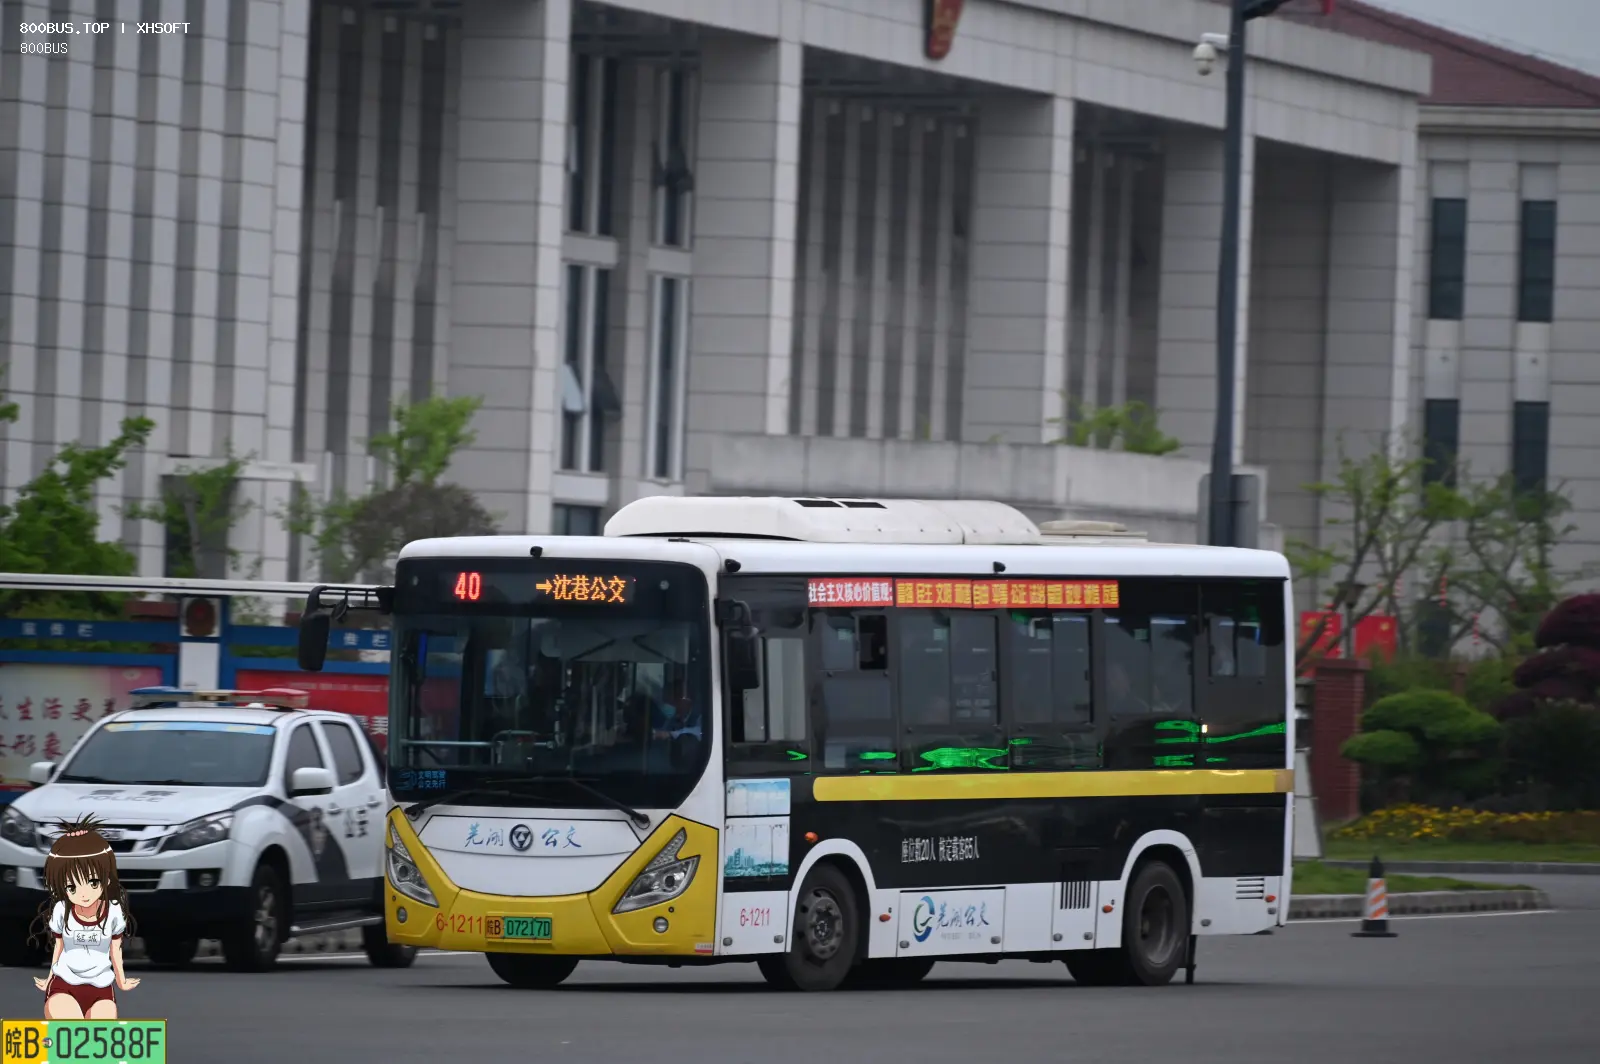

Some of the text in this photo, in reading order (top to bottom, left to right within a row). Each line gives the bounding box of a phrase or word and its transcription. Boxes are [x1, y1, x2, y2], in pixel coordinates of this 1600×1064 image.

[454, 571, 482, 600] 40
[552, 574, 626, 603] 沈巷公交
[328, 632, 388, 647] 传栏
[541, 827, 582, 849] 公交
[436, 912, 483, 935] 6-1211
[739, 908, 771, 927] 6-1211
